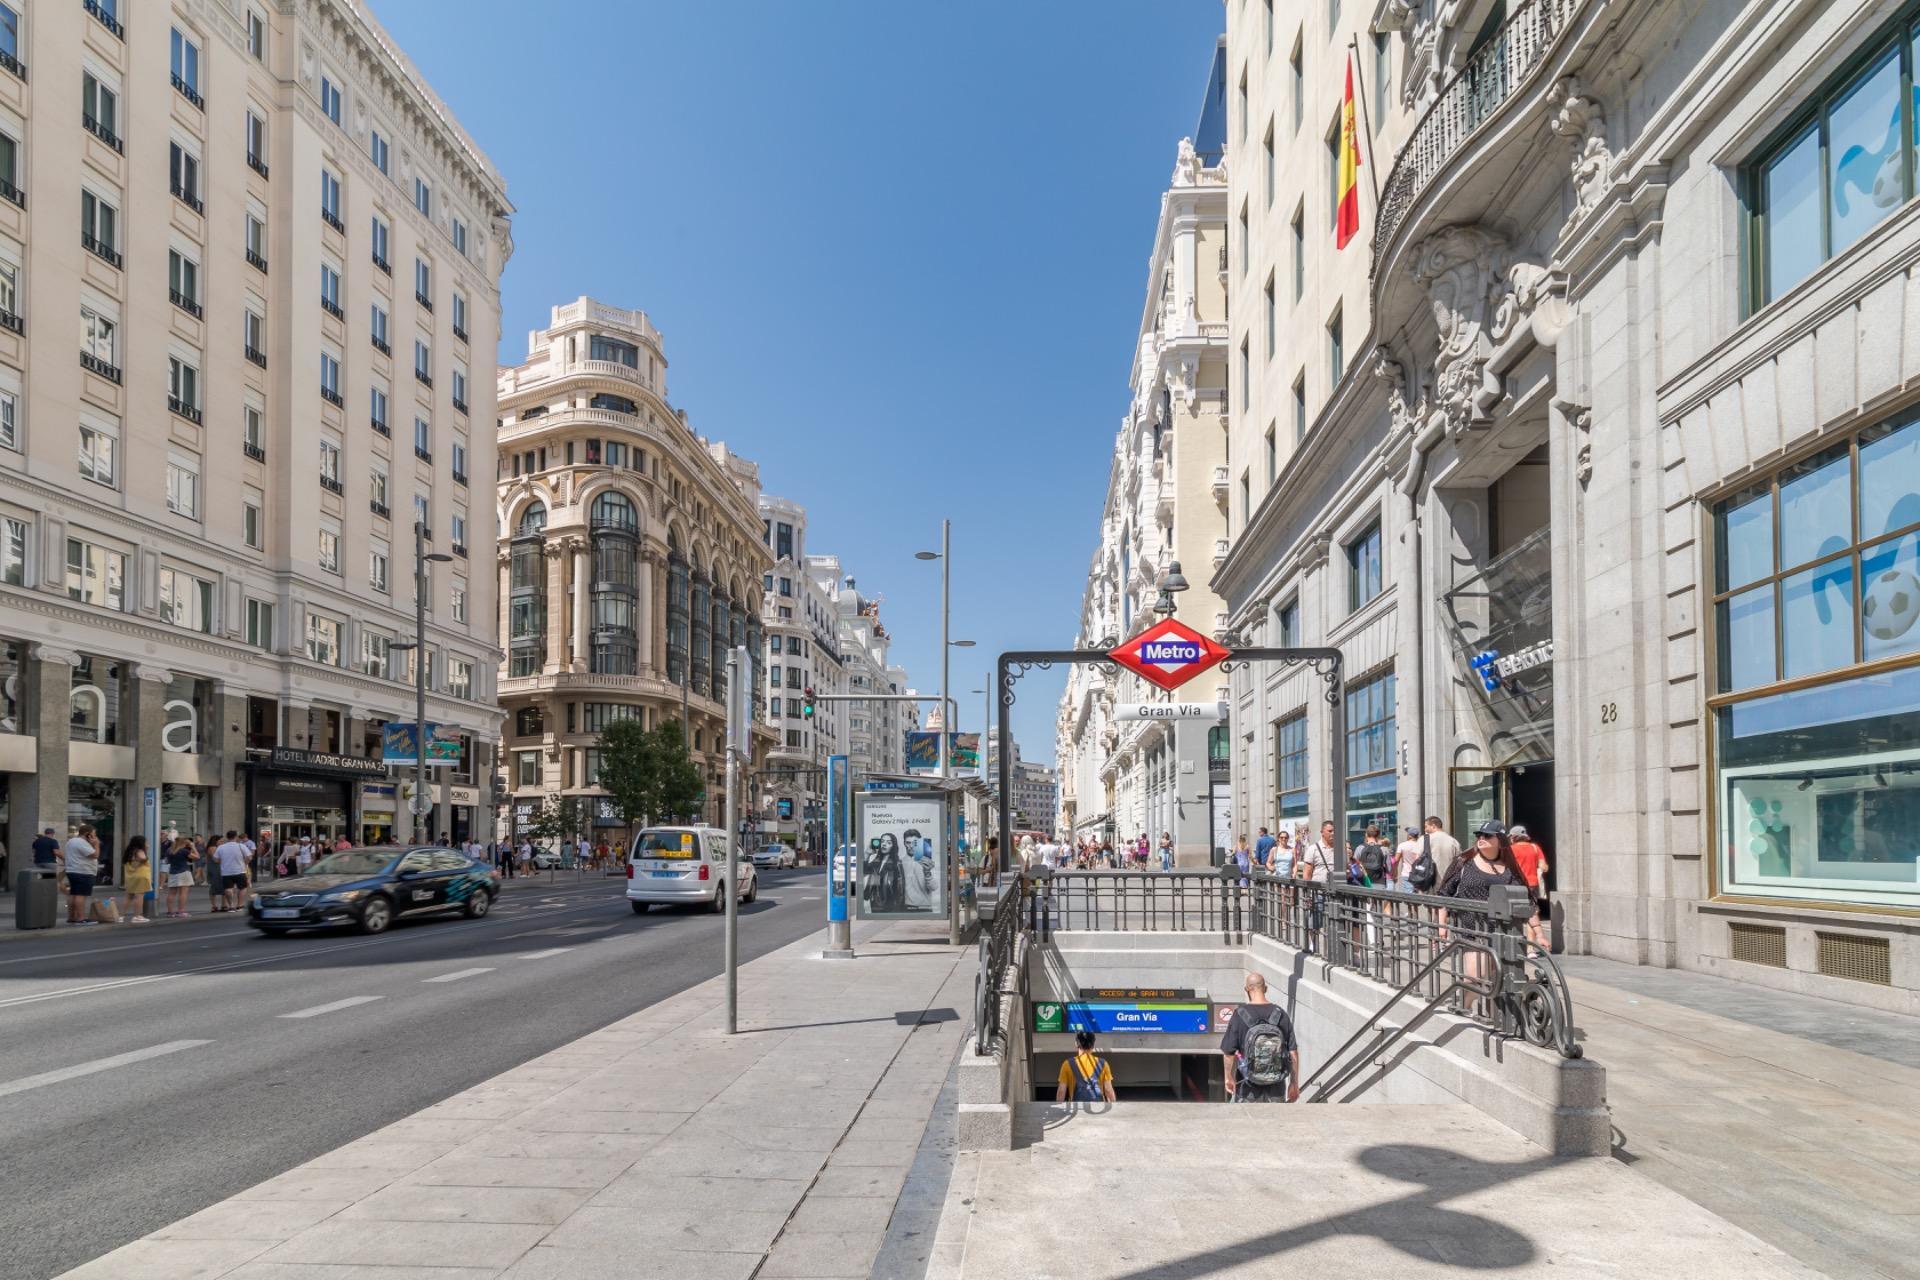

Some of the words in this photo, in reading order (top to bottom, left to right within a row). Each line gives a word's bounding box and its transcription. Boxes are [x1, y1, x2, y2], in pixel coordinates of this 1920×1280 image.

[1146, 644, 1196, 659] Metro
[1139, 705, 1174, 717] Gran
[1179, 705, 1201, 717] Vía
[1601, 702, 1617, 723] 28
[275, 750, 306, 763] HOTEL
[307, 754, 340, 767] MADRID
[341, 758, 363, 769] GRAN
[377, 761, 386, 772] 25
[451, 791, 469, 799] KIKO
[517, 805, 532, 815] JEANS
[1116, 1012, 1140, 1022] Gran
[1141, 1012, 1158, 1022] Vía
